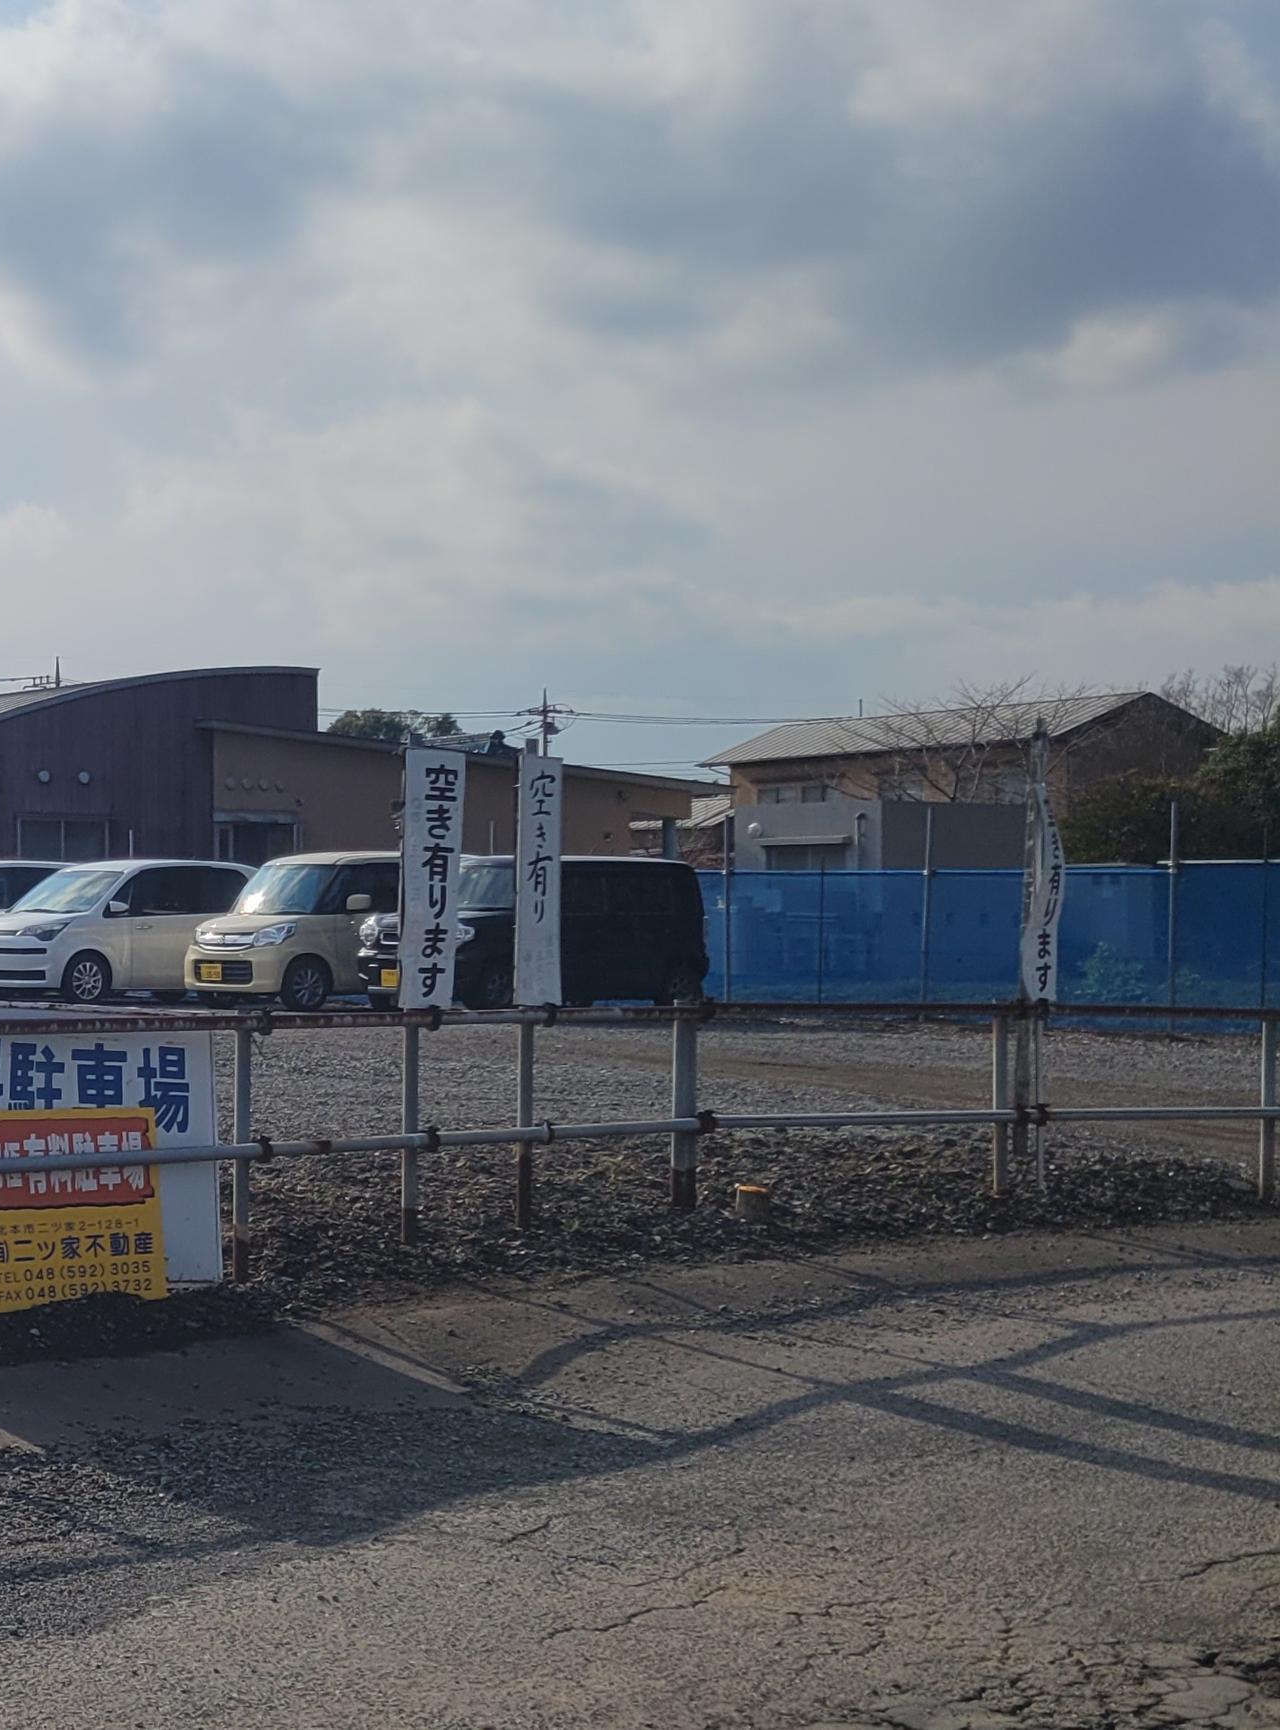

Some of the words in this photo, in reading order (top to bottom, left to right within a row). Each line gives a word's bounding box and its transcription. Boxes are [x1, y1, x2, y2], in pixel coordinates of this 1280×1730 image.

[418, 764, 458, 998] 空き有ります
[527, 769, 557, 924] 空き有り
